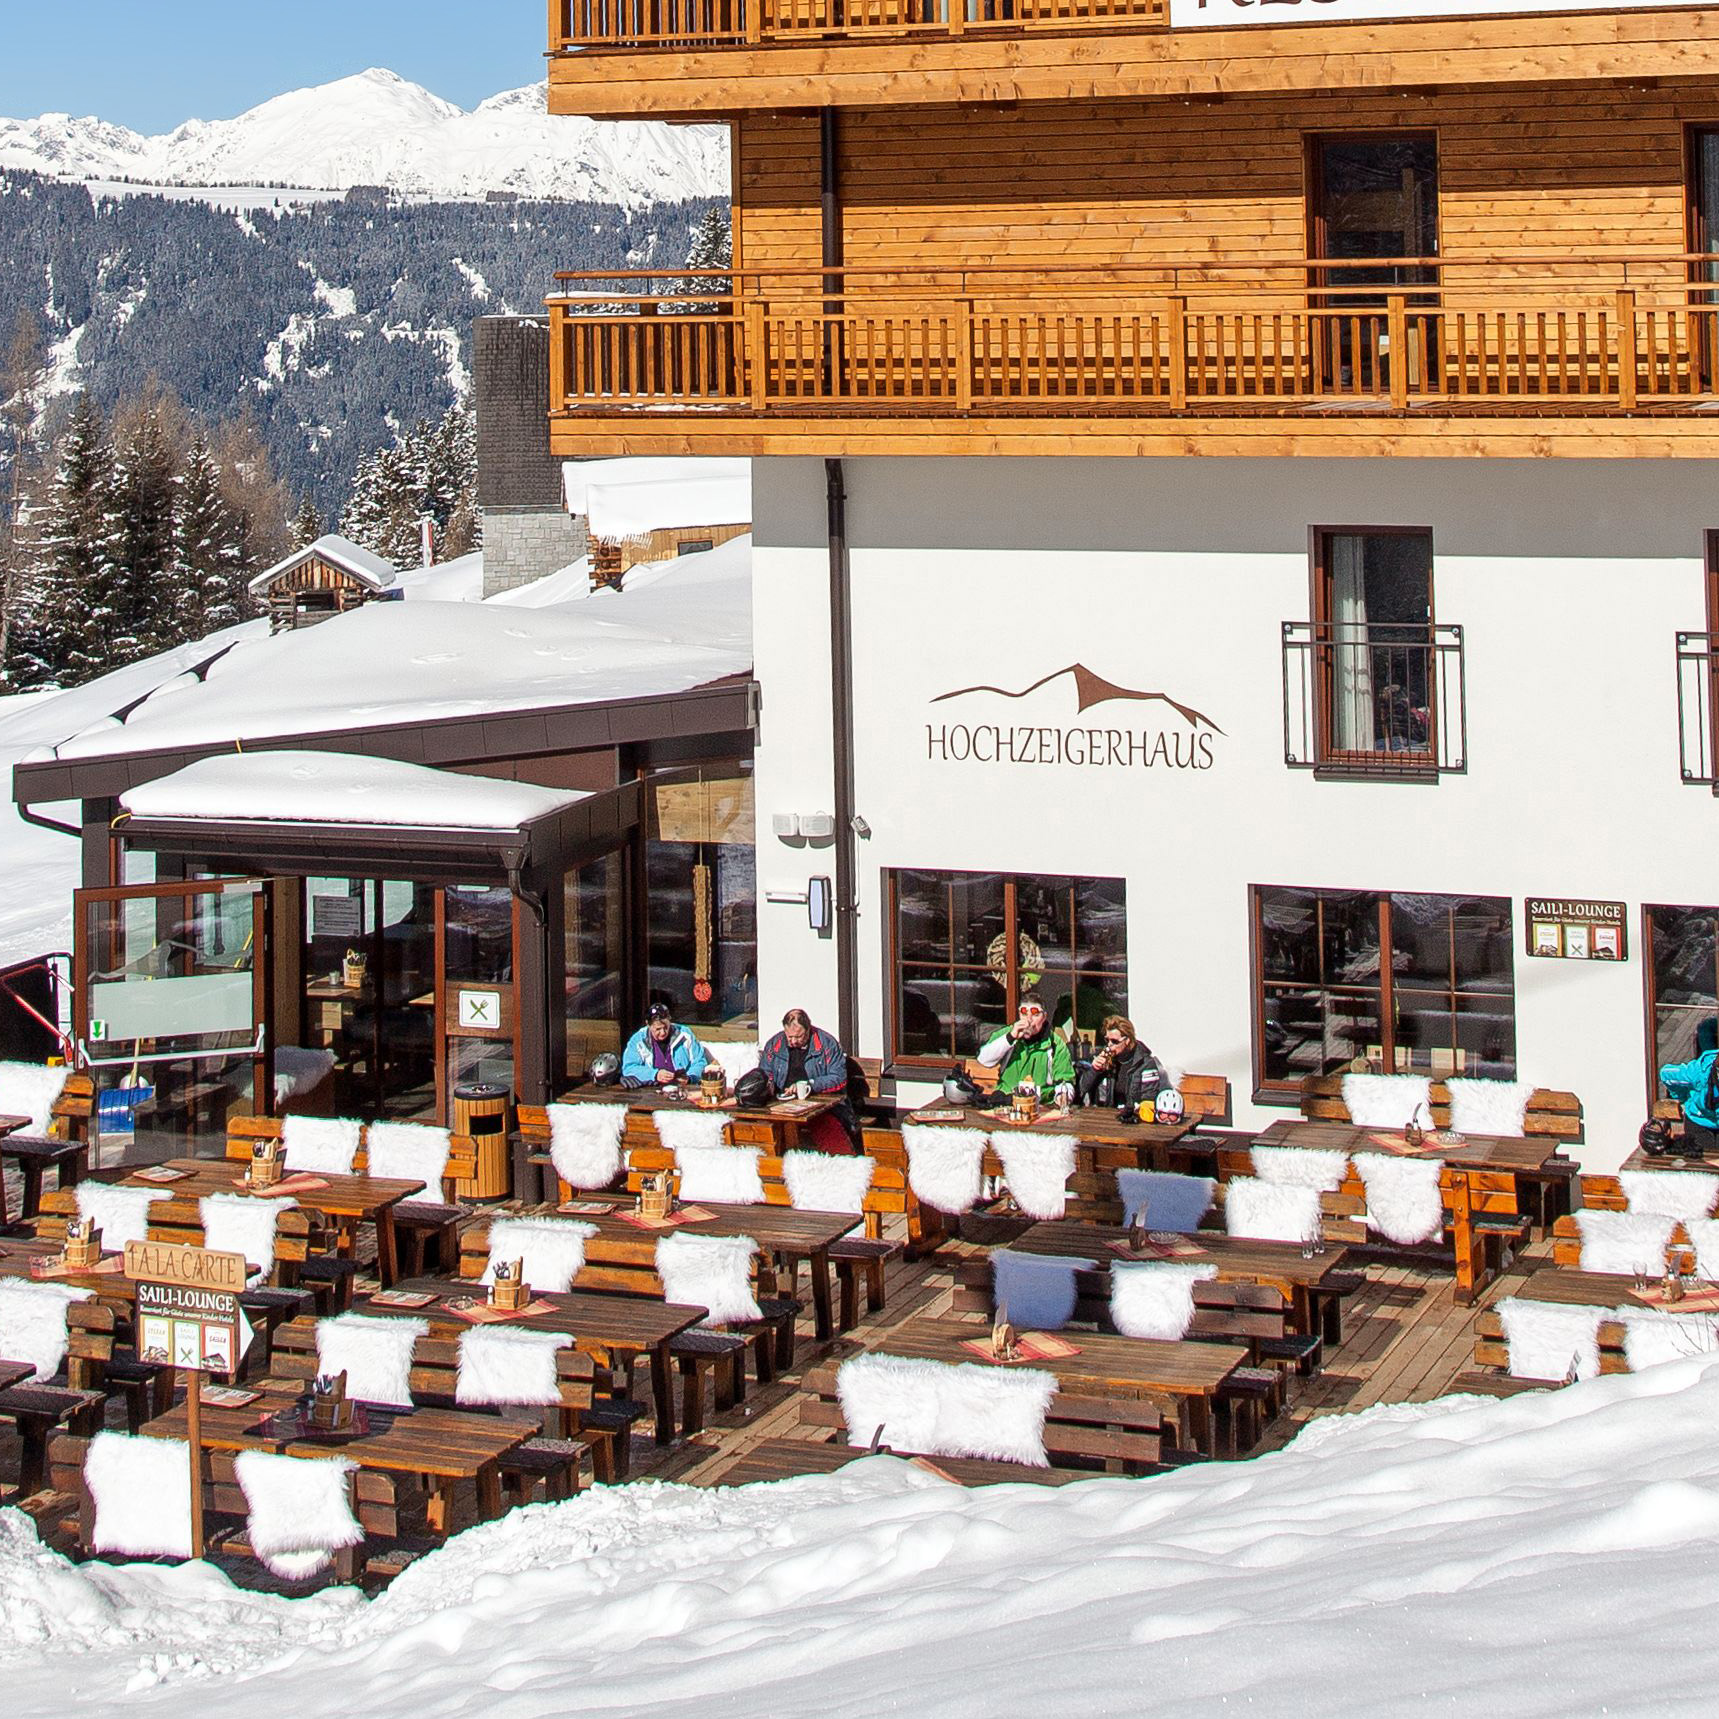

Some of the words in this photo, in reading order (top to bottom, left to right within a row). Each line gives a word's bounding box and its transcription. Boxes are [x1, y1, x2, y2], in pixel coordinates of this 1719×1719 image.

[925, 723, 1214, 770] HOCHZEIGERHAUS
[1531, 901, 1622, 918] SAILI-LOUNGE
[138, 1247, 152, 1275] A
[155, 1248, 178, 1277] LA
[181, 1251, 237, 1285] CARTE
[139, 1284, 235, 1313] SAILI-LOUNGE
